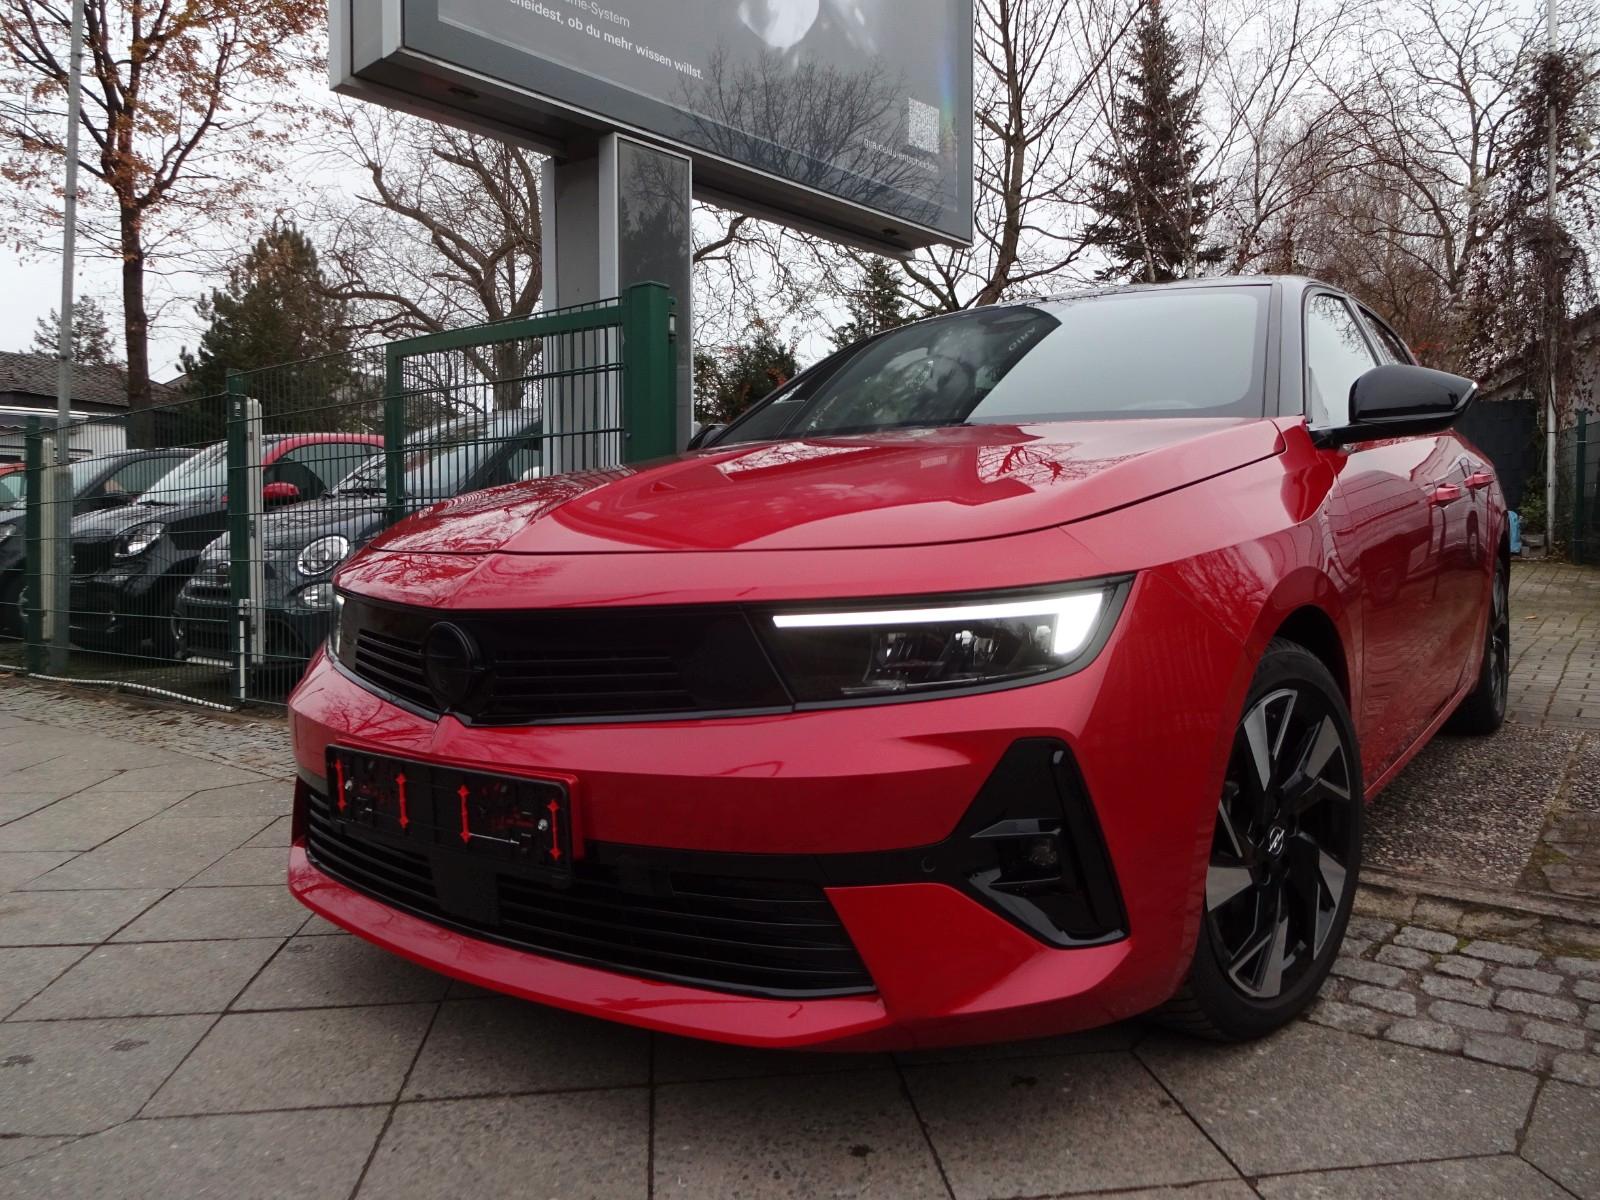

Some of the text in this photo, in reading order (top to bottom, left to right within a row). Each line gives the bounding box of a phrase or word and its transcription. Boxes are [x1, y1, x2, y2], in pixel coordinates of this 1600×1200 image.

[564, 0, 630, 28] me-System
[567, 17, 583, 31] ob
[585, 24, 601, 39] du
[603, 32, 634, 51] mehr
[635, 46, 672, 67] wissen
[674, 60, 704, 80] willst.
